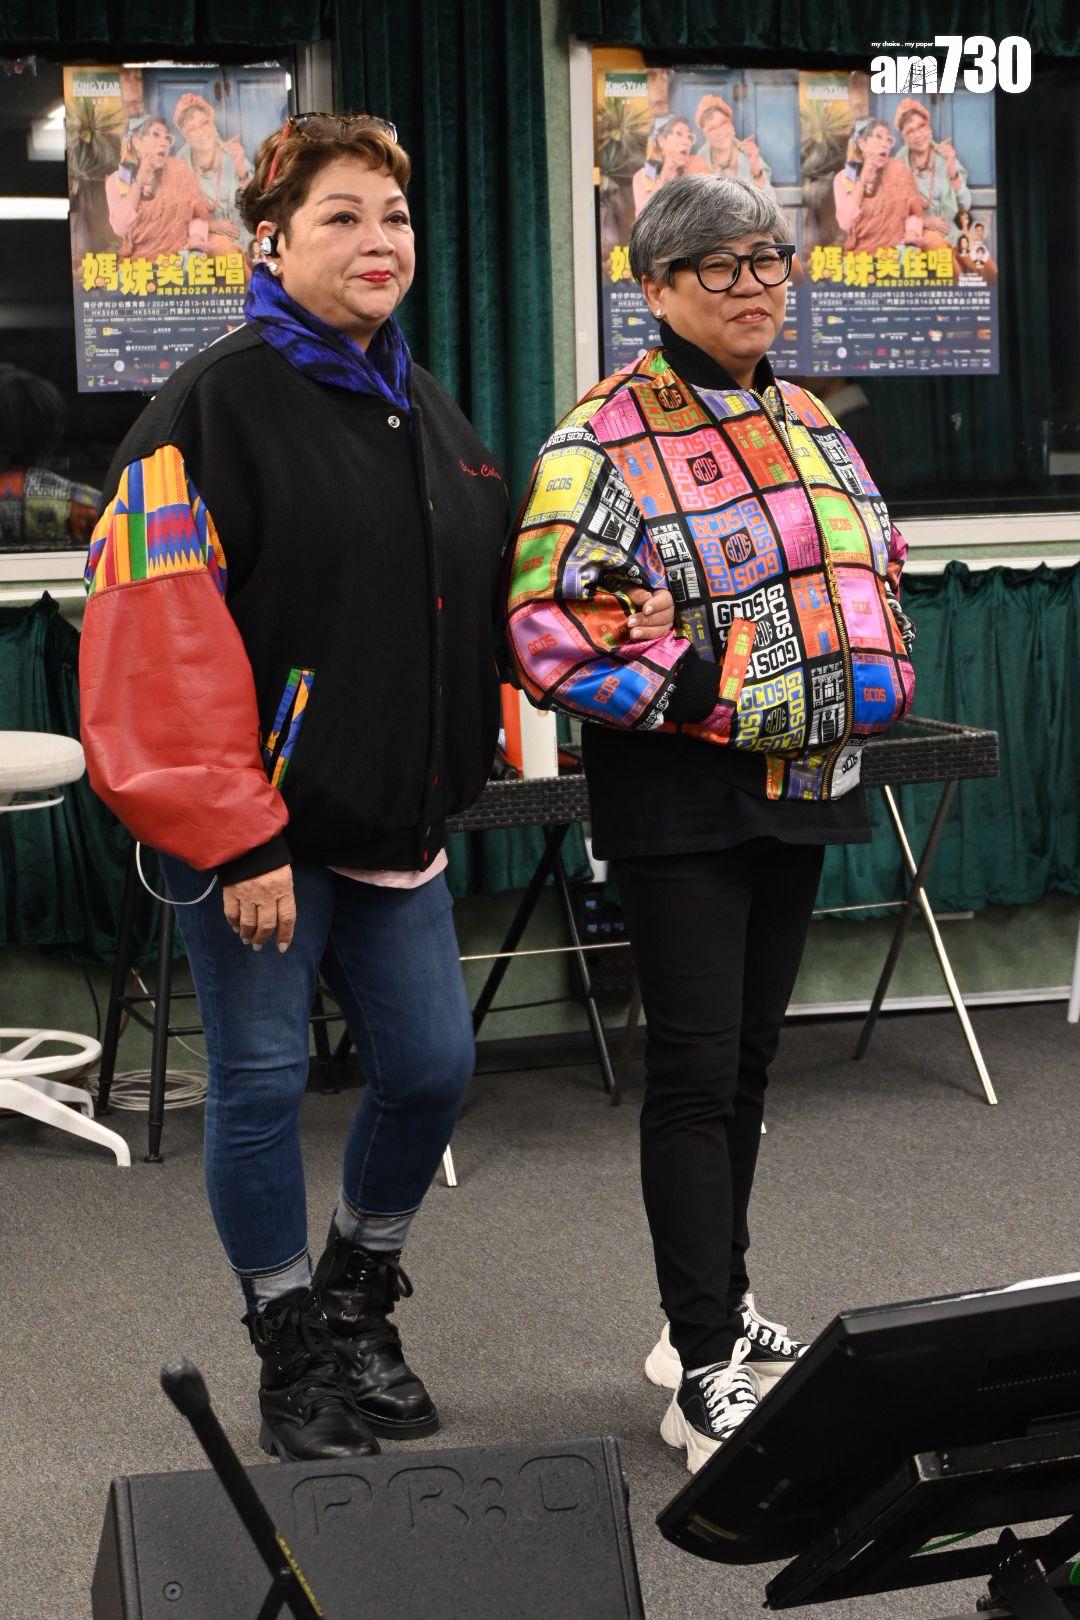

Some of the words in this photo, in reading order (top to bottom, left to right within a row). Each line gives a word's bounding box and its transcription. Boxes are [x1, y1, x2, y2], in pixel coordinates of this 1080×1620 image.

[211, 287, 245, 295] PART2
[924, 279, 954, 287] PART2
[545, 477, 573, 493] GCDS
[691, 506, 742, 538] GCDS
[740, 499, 775, 551] GCDS
[698, 541, 733, 593] GCDS
[732, 551, 780, 591] GCDS
[767, 583, 794, 639] GCDS
[528, 633, 557, 656] GCDS
[756, 639, 798, 675] GCDS
[592, 673, 621, 704] GCDS
[740, 680, 784, 712] GCDS
[785, 671, 806, 728] GCDS
[863, 686, 887, 703] GCDS
